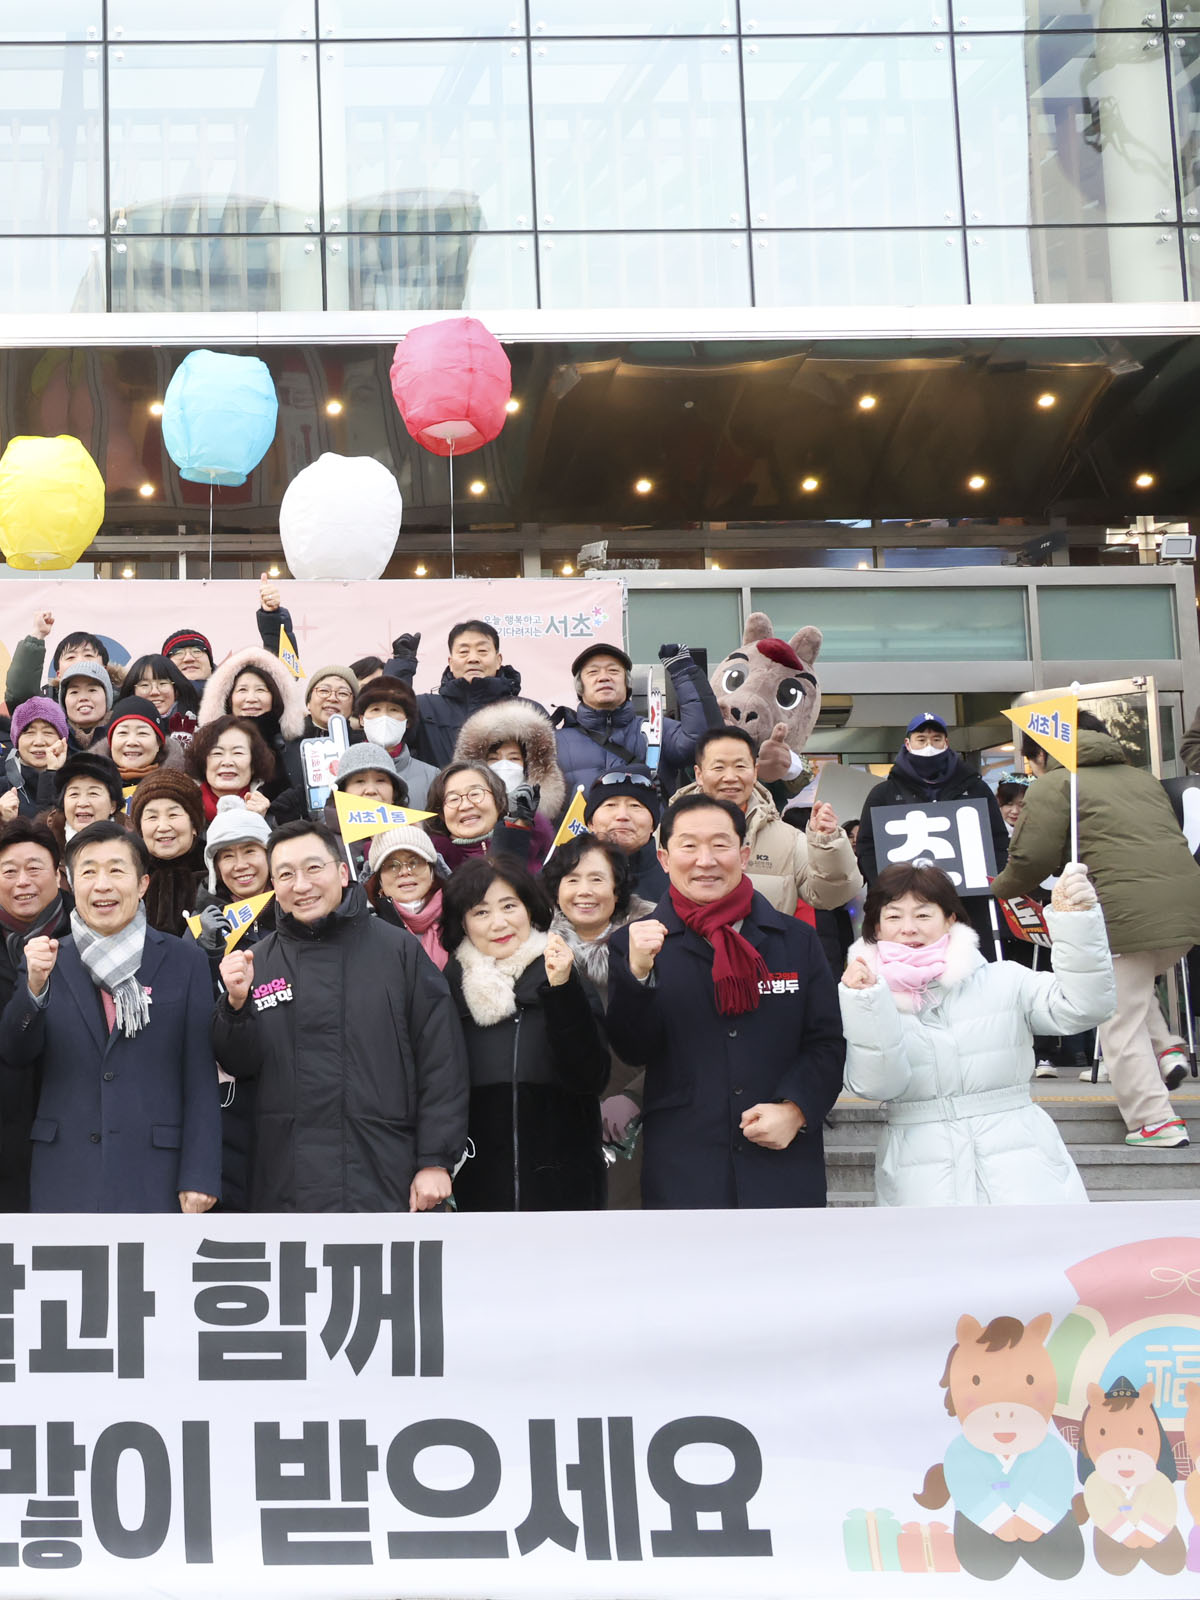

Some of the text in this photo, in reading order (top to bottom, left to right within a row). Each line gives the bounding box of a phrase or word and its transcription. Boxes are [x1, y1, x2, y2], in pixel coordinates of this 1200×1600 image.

[484, 615, 542, 626] 오늘 행복하고
[545, 613, 594, 638] 서초
[1027, 712, 1070, 742] 서초1동
[348, 806, 405, 824] 서초1동
[193, 1239, 444, 1381] 함께
[254, 1416, 773, 1565] 받으세요
